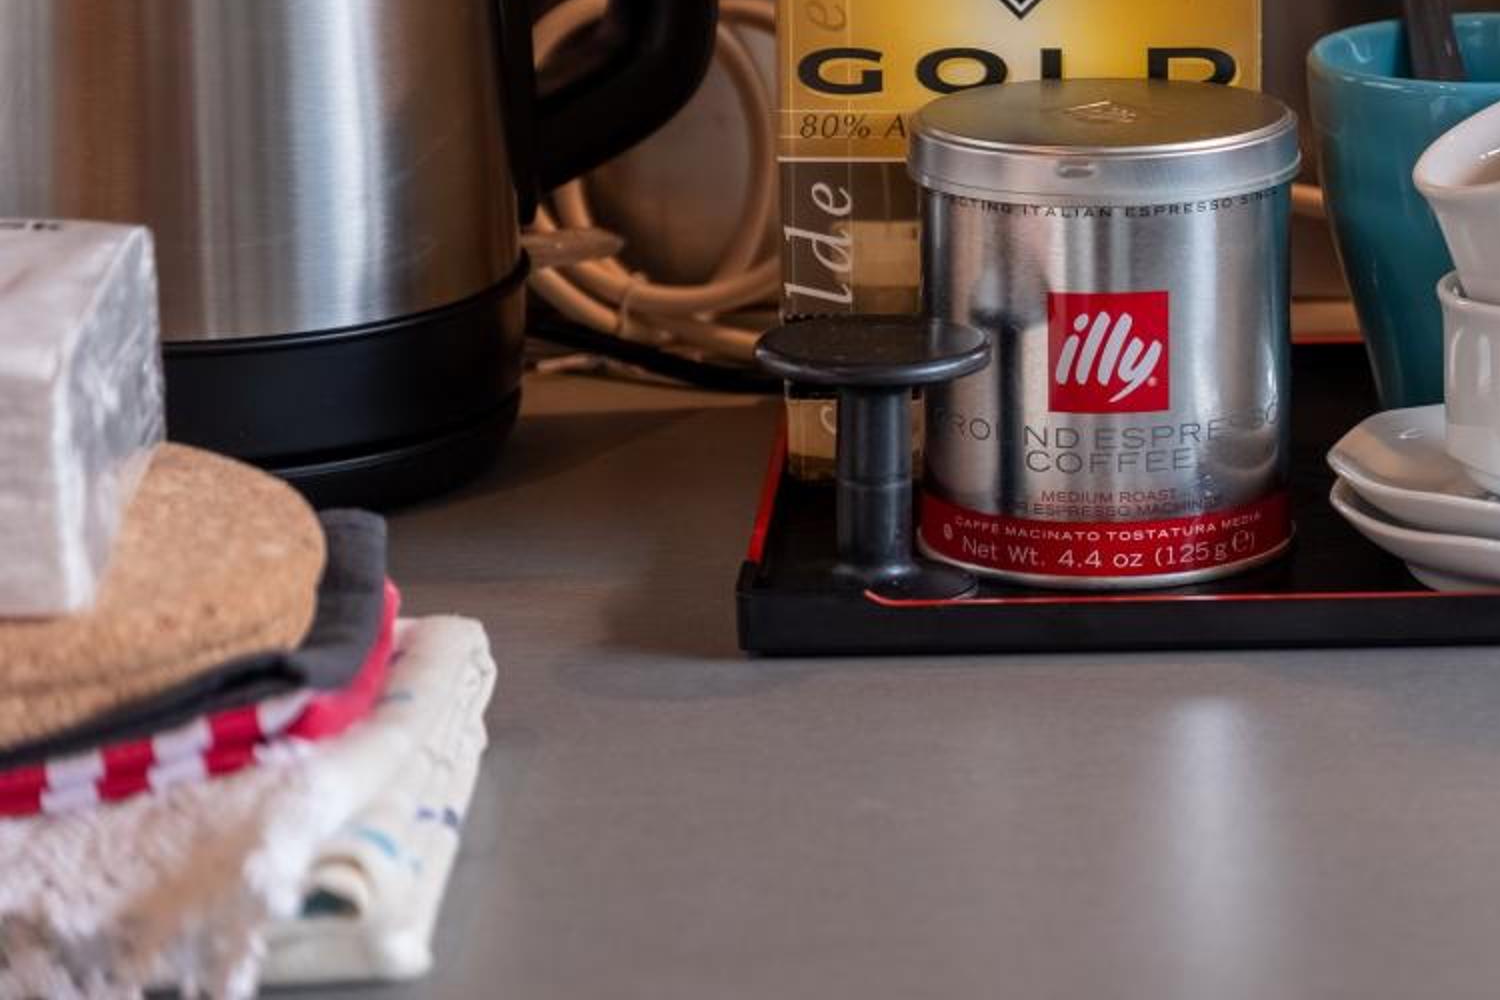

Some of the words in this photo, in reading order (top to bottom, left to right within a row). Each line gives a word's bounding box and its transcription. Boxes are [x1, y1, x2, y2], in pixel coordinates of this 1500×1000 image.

[799, 113, 871, 139] 80%
[1023, 203, 1112, 218] ITALIAN
[1125, 200, 1233, 218] ESPRESSO
[1055, 310, 1163, 403] illy
[1026, 447, 1194, 475] COFFEE
[1041, 490, 1113, 503] MEDIUM
[1119, 487, 1177, 503] ROAST
[1004, 525, 1100, 541] MACINATO
[1106, 523, 1217, 542] TOSTATURA
[961, 535, 999, 562] Net
[1007, 545, 1046, 567] Wt.
[1057, 549, 1102, 569] 4.4
[1112, 552, 1143, 568] oz
